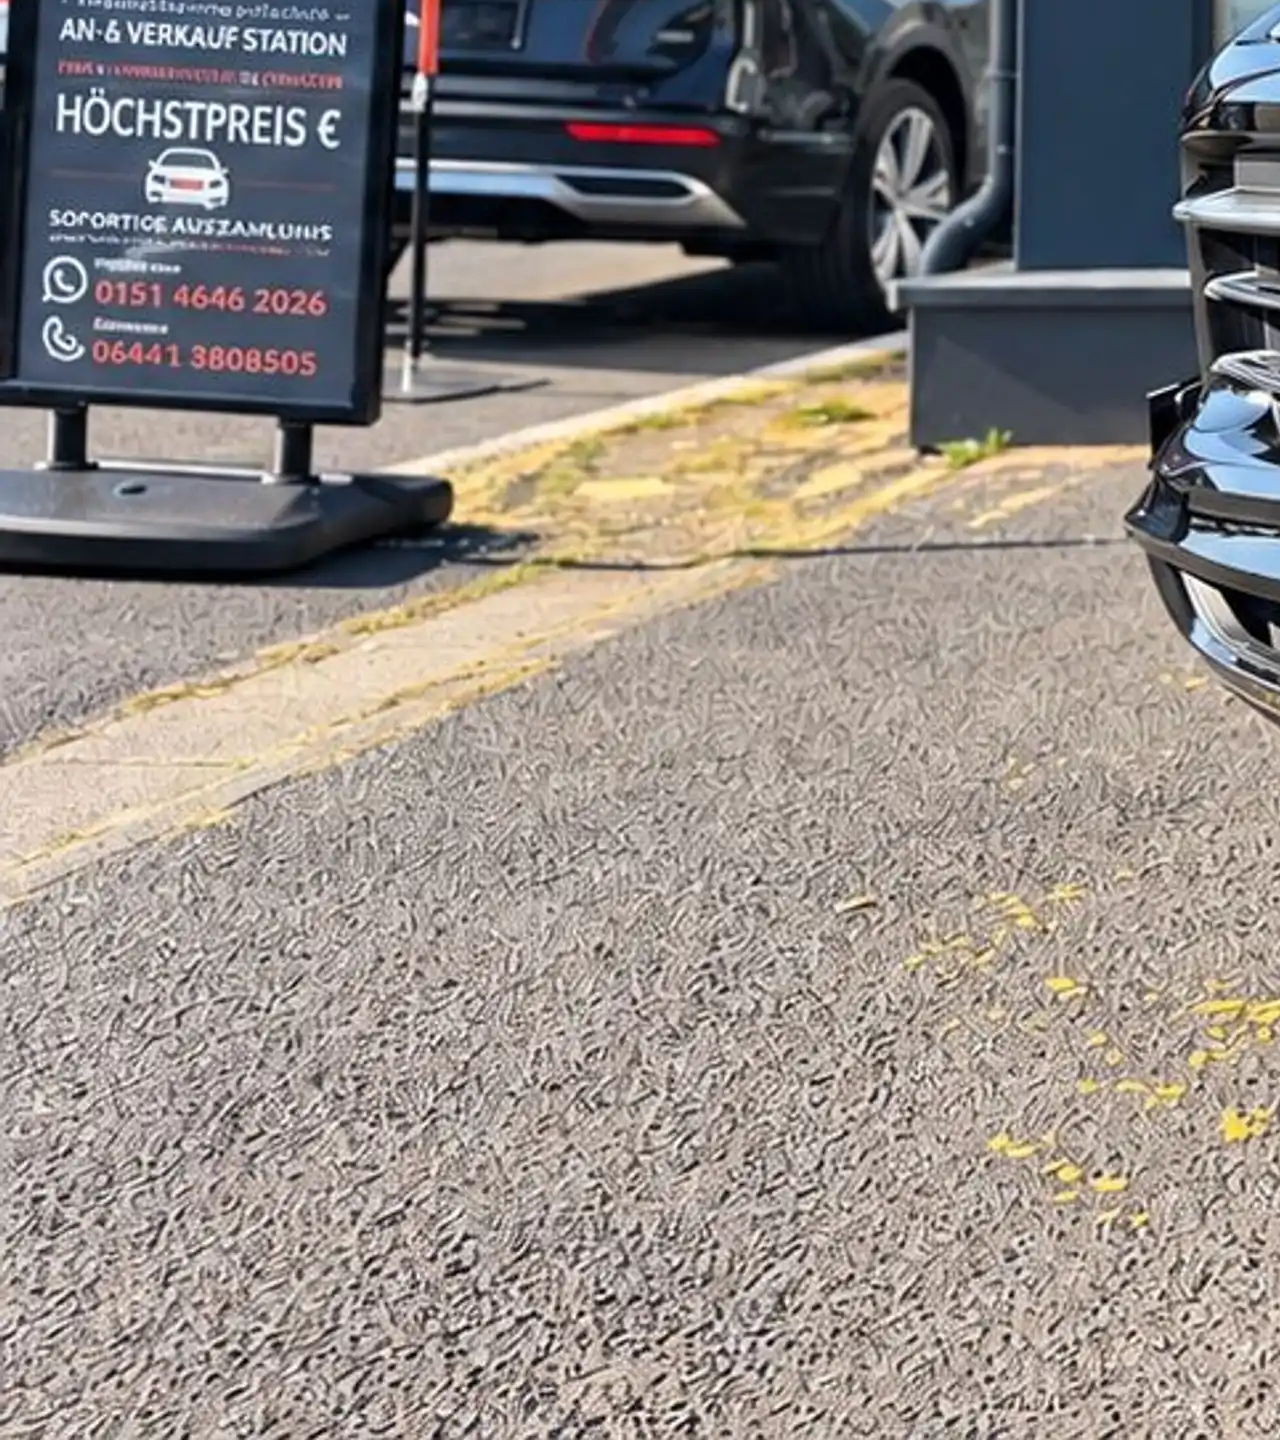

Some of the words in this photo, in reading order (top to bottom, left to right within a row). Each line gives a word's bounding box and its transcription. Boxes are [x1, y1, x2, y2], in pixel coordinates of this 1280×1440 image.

[126, 21, 239, 50] VERKAUF
[243, 27, 347, 57] STATION
[56, 88, 306, 147] HÖCHSTPREIS
[317, 109, 342, 149] €
[95, 279, 163, 308] 0151
[174, 286, 245, 313] 4646
[253, 288, 328, 317] 2026
[92, 339, 181, 368] 06441
[190, 344, 318, 376] 3808505
